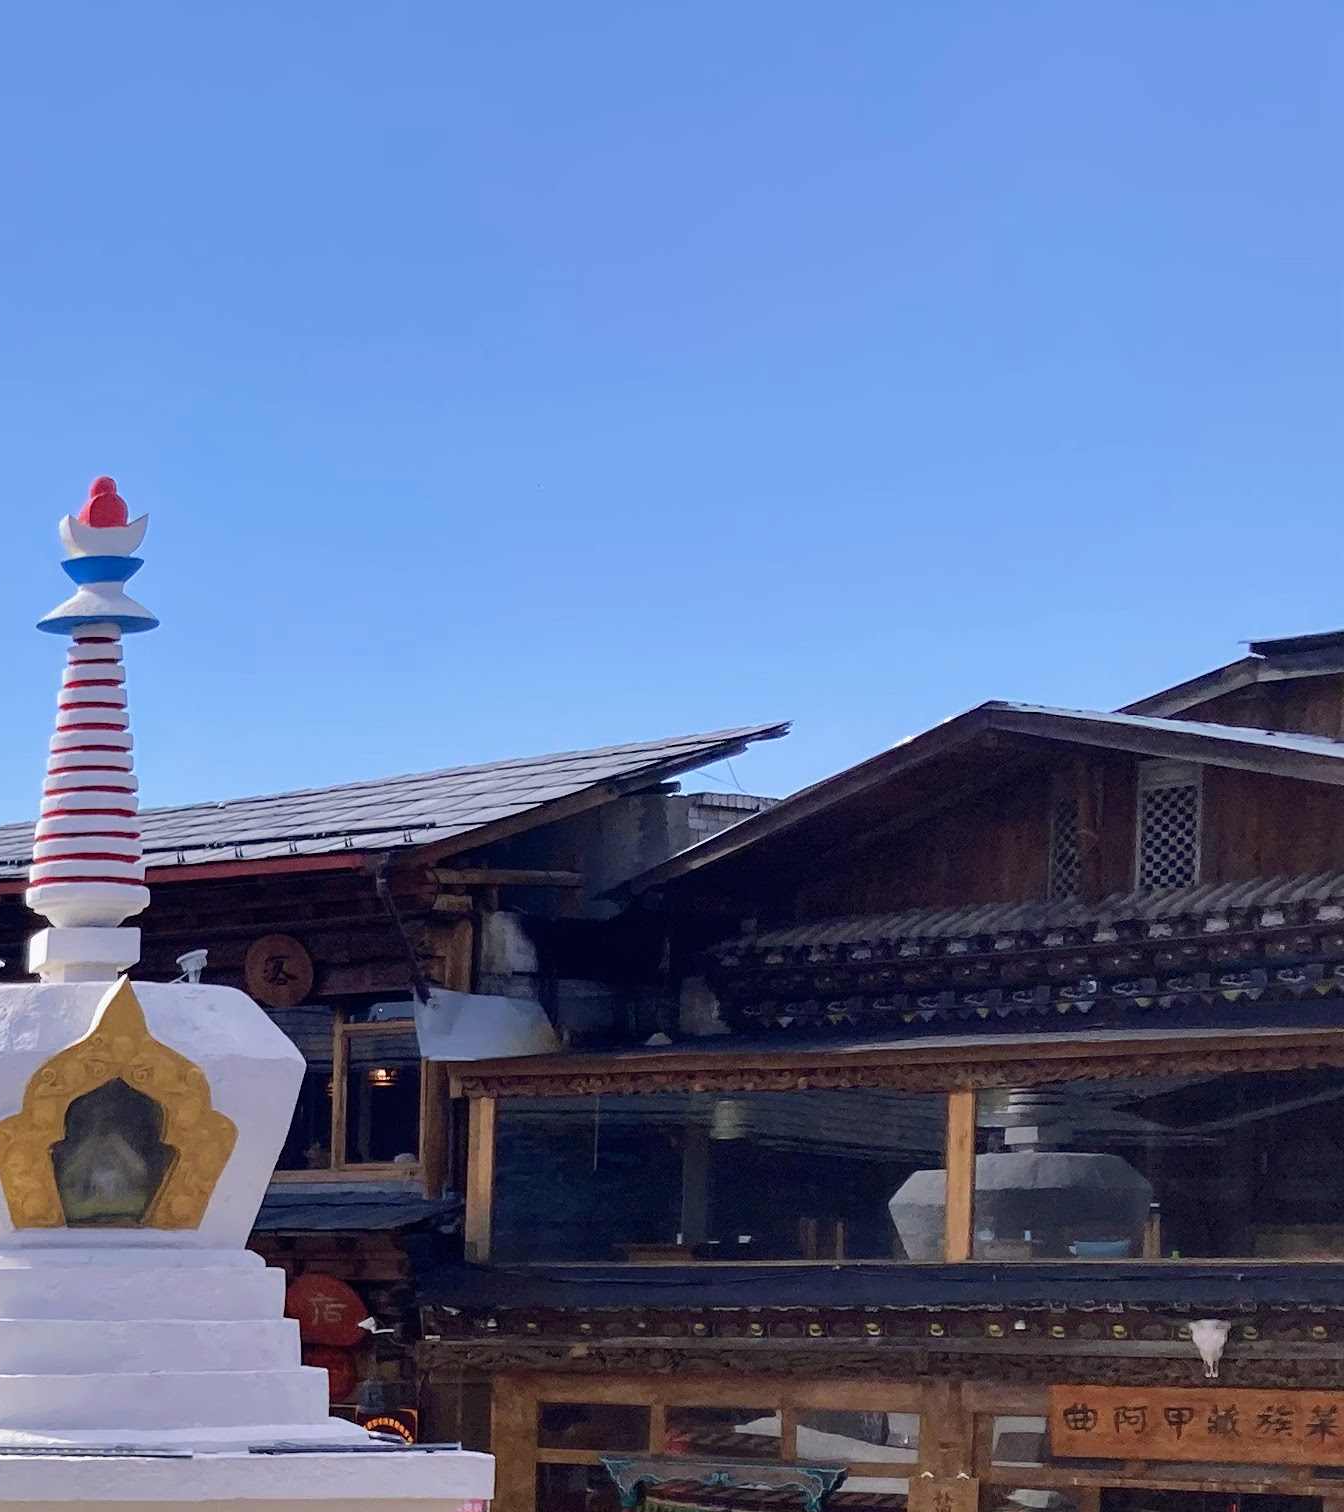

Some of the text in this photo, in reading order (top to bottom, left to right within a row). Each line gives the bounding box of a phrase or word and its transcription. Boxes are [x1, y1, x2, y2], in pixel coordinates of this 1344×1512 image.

[1063, 1403, 1340, 1443] 曲阿甲藏族菜
